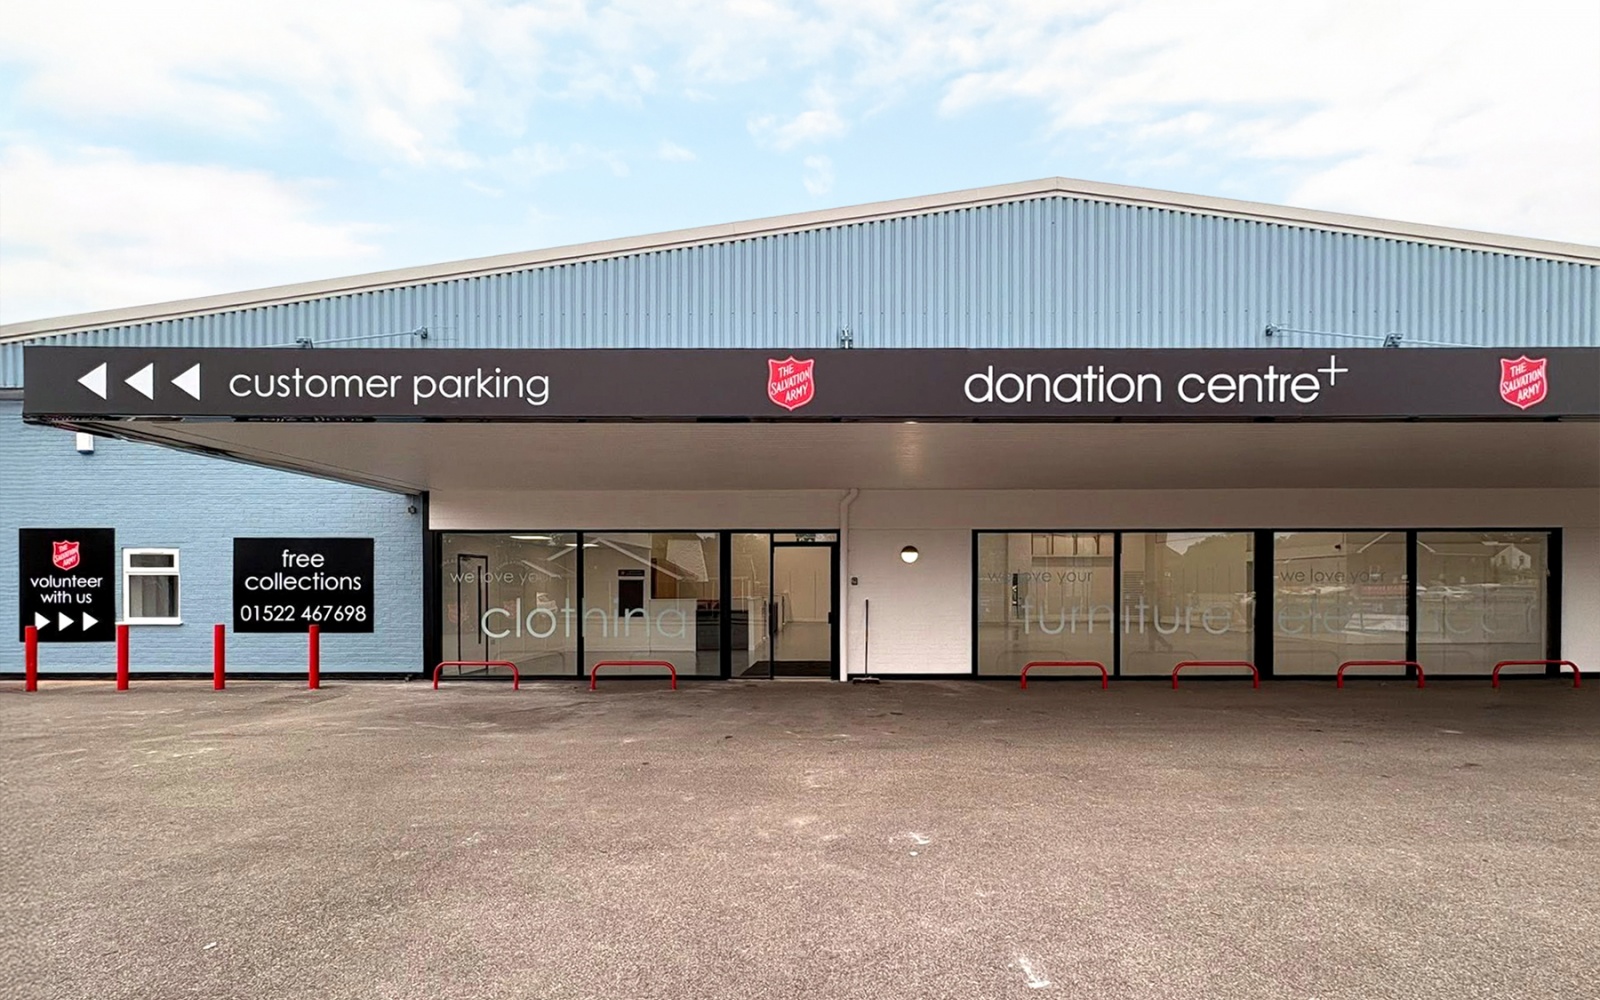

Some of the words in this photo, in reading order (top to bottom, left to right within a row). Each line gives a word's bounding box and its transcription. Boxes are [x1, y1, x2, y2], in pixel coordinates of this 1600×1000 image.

[778, 363, 795, 378] THE
[1510, 361, 1527, 378] THE
[229, 367, 403, 398] customer
[413, 367, 550, 406] parking
[771, 366, 811, 396] SALVATION
[964, 365, 1162, 404] donation
[1502, 365, 1543, 395] SALVATION
[784, 382, 808, 403] ARMY
[1517, 380, 1541, 402] ARMY
[281, 549, 325, 568] free
[30, 574, 103, 588] volunteer
[244, 572, 362, 590] collections
[450, 572, 475, 583] we
[480, 568, 514, 583] love
[519, 572, 551, 586] yo
[1057, 571, 1093, 585] your
[1280, 571, 1306, 582] we
[1310, 567, 1346, 583] love
[40, 590, 72, 603] with
[76, 593, 93, 604] us
[240, 605, 295, 621] 01522
[300, 605, 367, 621] 467698
[1021, 594, 1232, 635] furniture
